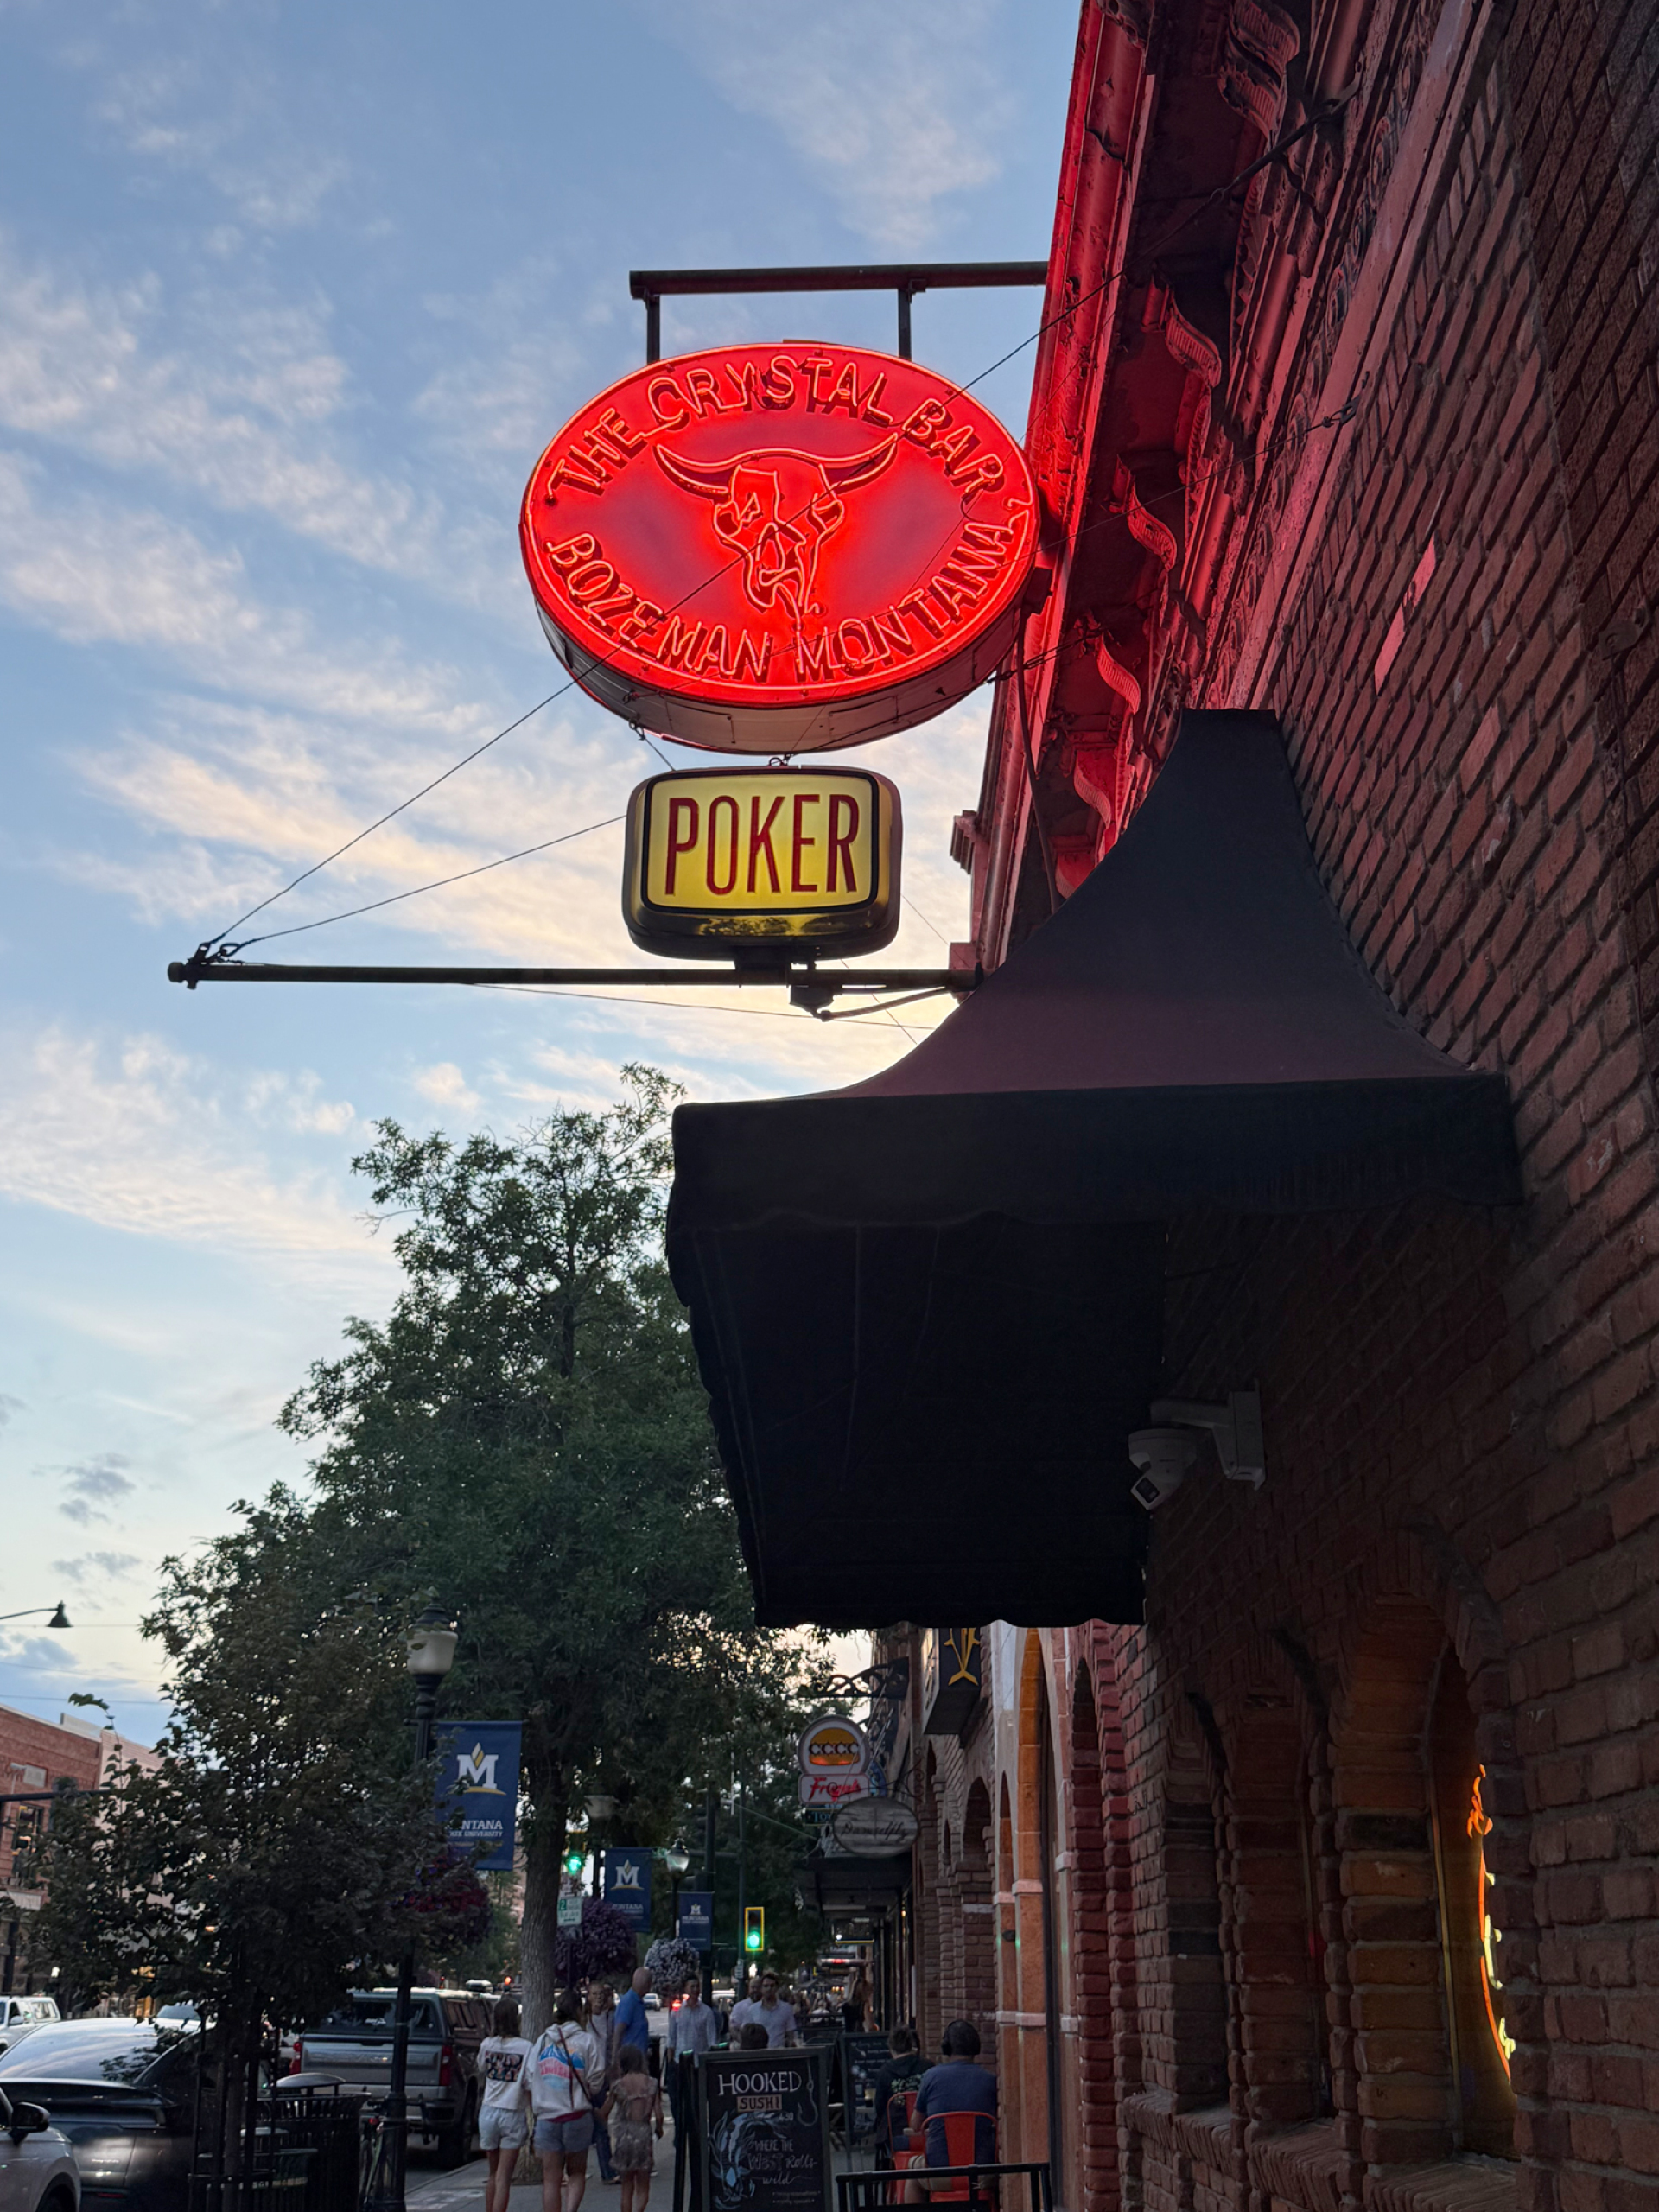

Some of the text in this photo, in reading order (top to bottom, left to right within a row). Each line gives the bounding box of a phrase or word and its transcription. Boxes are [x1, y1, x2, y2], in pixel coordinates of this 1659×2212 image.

[549, 355, 1005, 503] THE CRYSTAL BAR
[546, 521, 1014, 683] BOZEMAN MONTANA
[664, 793, 861, 896] POKER
[448, 1819, 503, 1830] NTANA
[717, 2070, 803, 2096] HOOKED
[739, 2096, 780, 2110] SUSHI
[781, 2139, 794, 2152] THE
